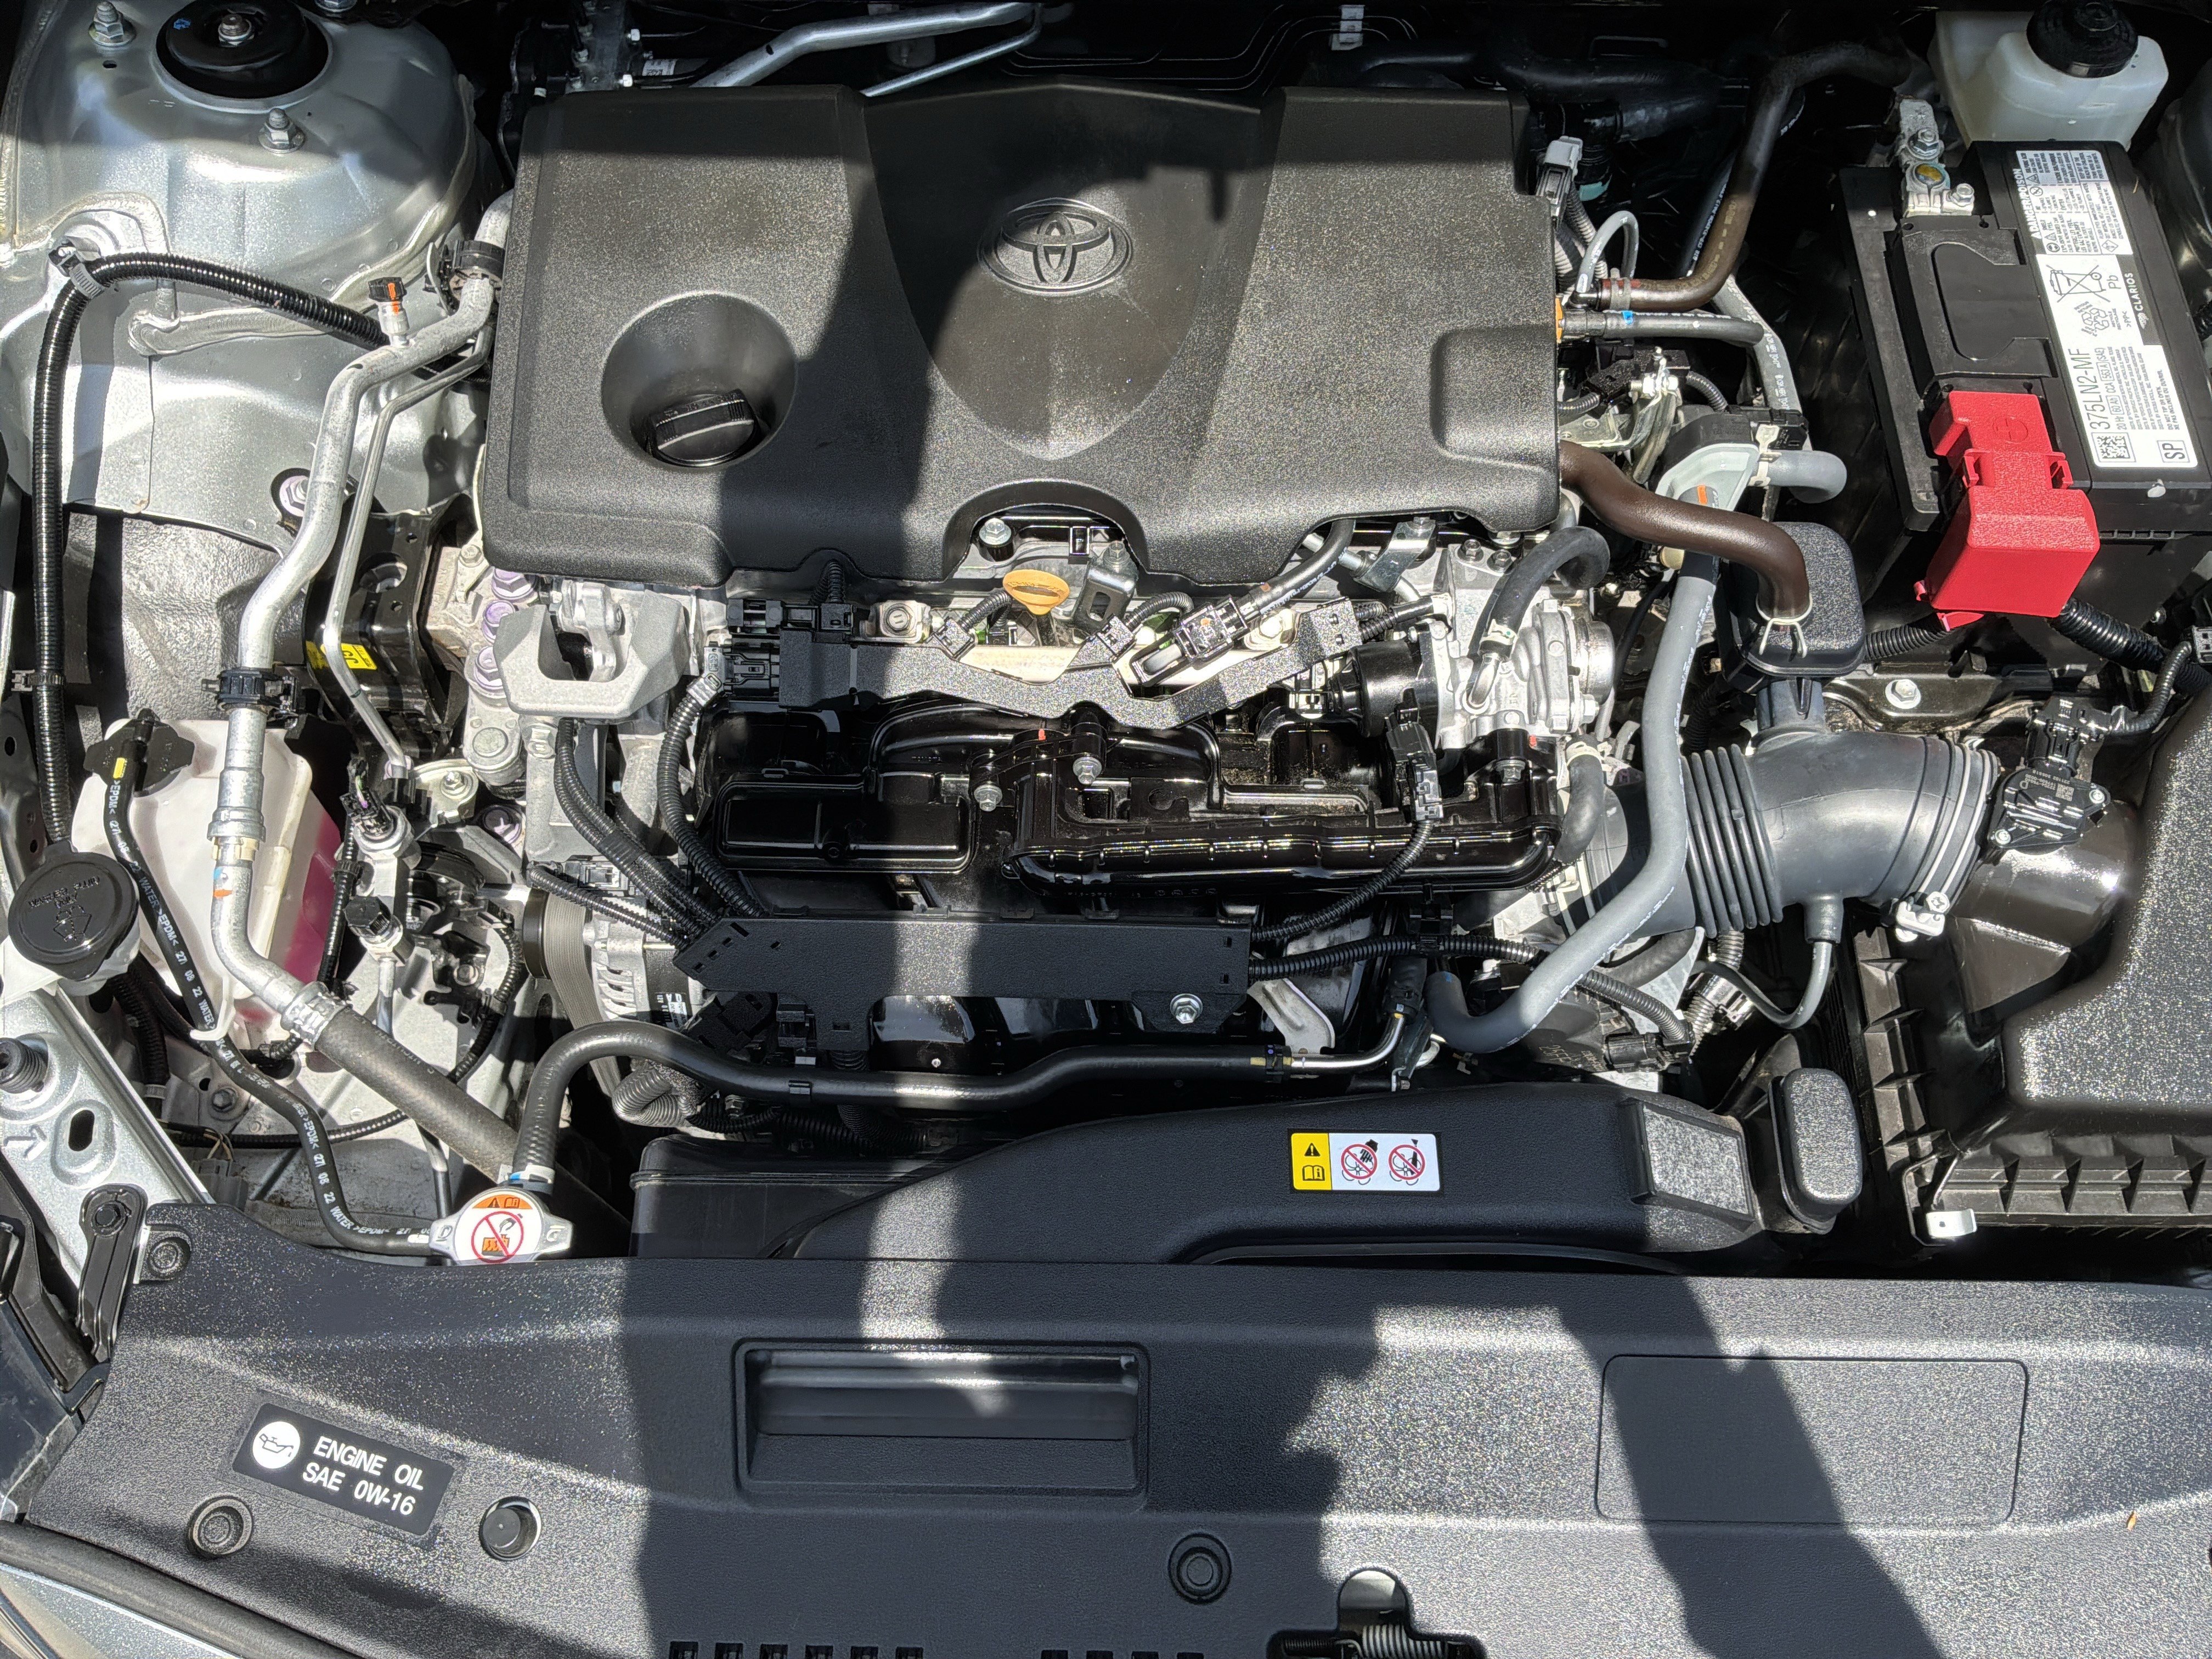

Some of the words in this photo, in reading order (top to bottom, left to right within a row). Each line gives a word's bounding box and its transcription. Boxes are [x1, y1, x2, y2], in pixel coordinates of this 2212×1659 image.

[2012, 168, 2039, 232] DANGER/POISON
[2104, 275, 2121, 289] Pb
[2123, 272, 2144, 311] CLARIOS
[2068, 348, 2111, 430] 375LN2-MF
[2160, 442, 2186, 459] SP
[192, 986, 203, 998] 22
[318, 1172, 330, 1185] 08
[323, 1191, 336, 1204] 22
[330, 1206, 355, 1230] WATER
[313, 1436, 387, 1476] ENGINE
[394, 1464, 424, 1491] OIL
[302, 1462, 346, 1491] SAE
[354, 1480, 416, 1515] 0W-16
